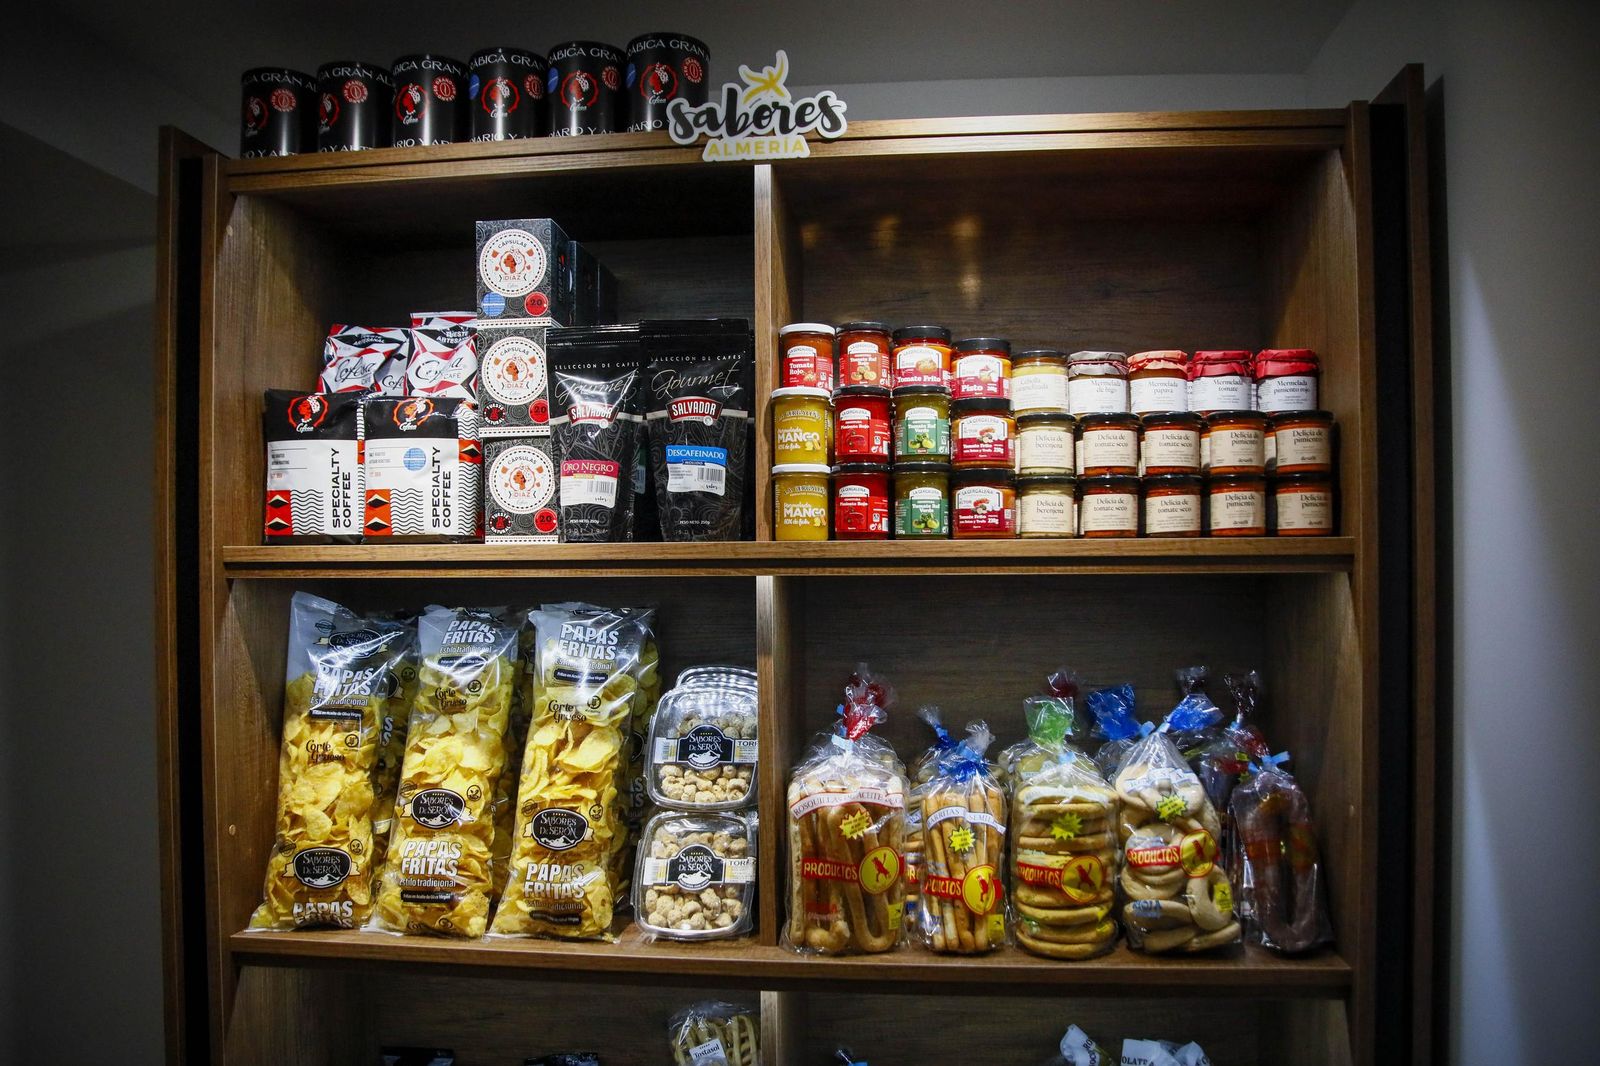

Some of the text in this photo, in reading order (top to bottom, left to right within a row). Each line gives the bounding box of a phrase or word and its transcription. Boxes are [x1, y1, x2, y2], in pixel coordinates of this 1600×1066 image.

[708, 140, 804, 157] ALMERÍA
[651, 360, 741, 400] Gourmet
[672, 400, 716, 416] SALVADOR
[778, 432, 820, 442] MANGO
[668, 448, 724, 460] DESCAFEINADO
[331, 448, 340, 528] SPECIALTY
[432, 446, 440, 528] SPECIALTY
[342, 472, 352, 528] COFFEE
[442, 470, 452, 528] COFFEE
[784, 508, 826, 518] MANGO
[442, 630, 496, 644] FRITAS
[560, 624, 620, 646] PAPAS
[558, 640, 617, 660] FRITAS
[318, 664, 374, 680] PAPAS
[434, 687, 456, 700] Corte
[548, 700, 574, 712] Corte
[306, 739, 332, 753] Corte
[689, 734, 722, 744] SABORES
[420, 794, 454, 805] SABORES
[540, 814, 577, 826] SABORES
[404, 841, 462, 859] PAPAS
[303, 854, 341, 866] SABORES
[402, 858, 458, 876] FRITAS
[679, 854, 713, 864] SABORES
[526, 862, 584, 881] PAPAS
[804, 862, 858, 880] PRODUCTOS
[417, 878, 456, 887] tradicional
[524, 881, 585, 899] FRITAS
[293, 900, 353, 917] PAPAS
[694, 1043, 720, 1058] Tostasol
